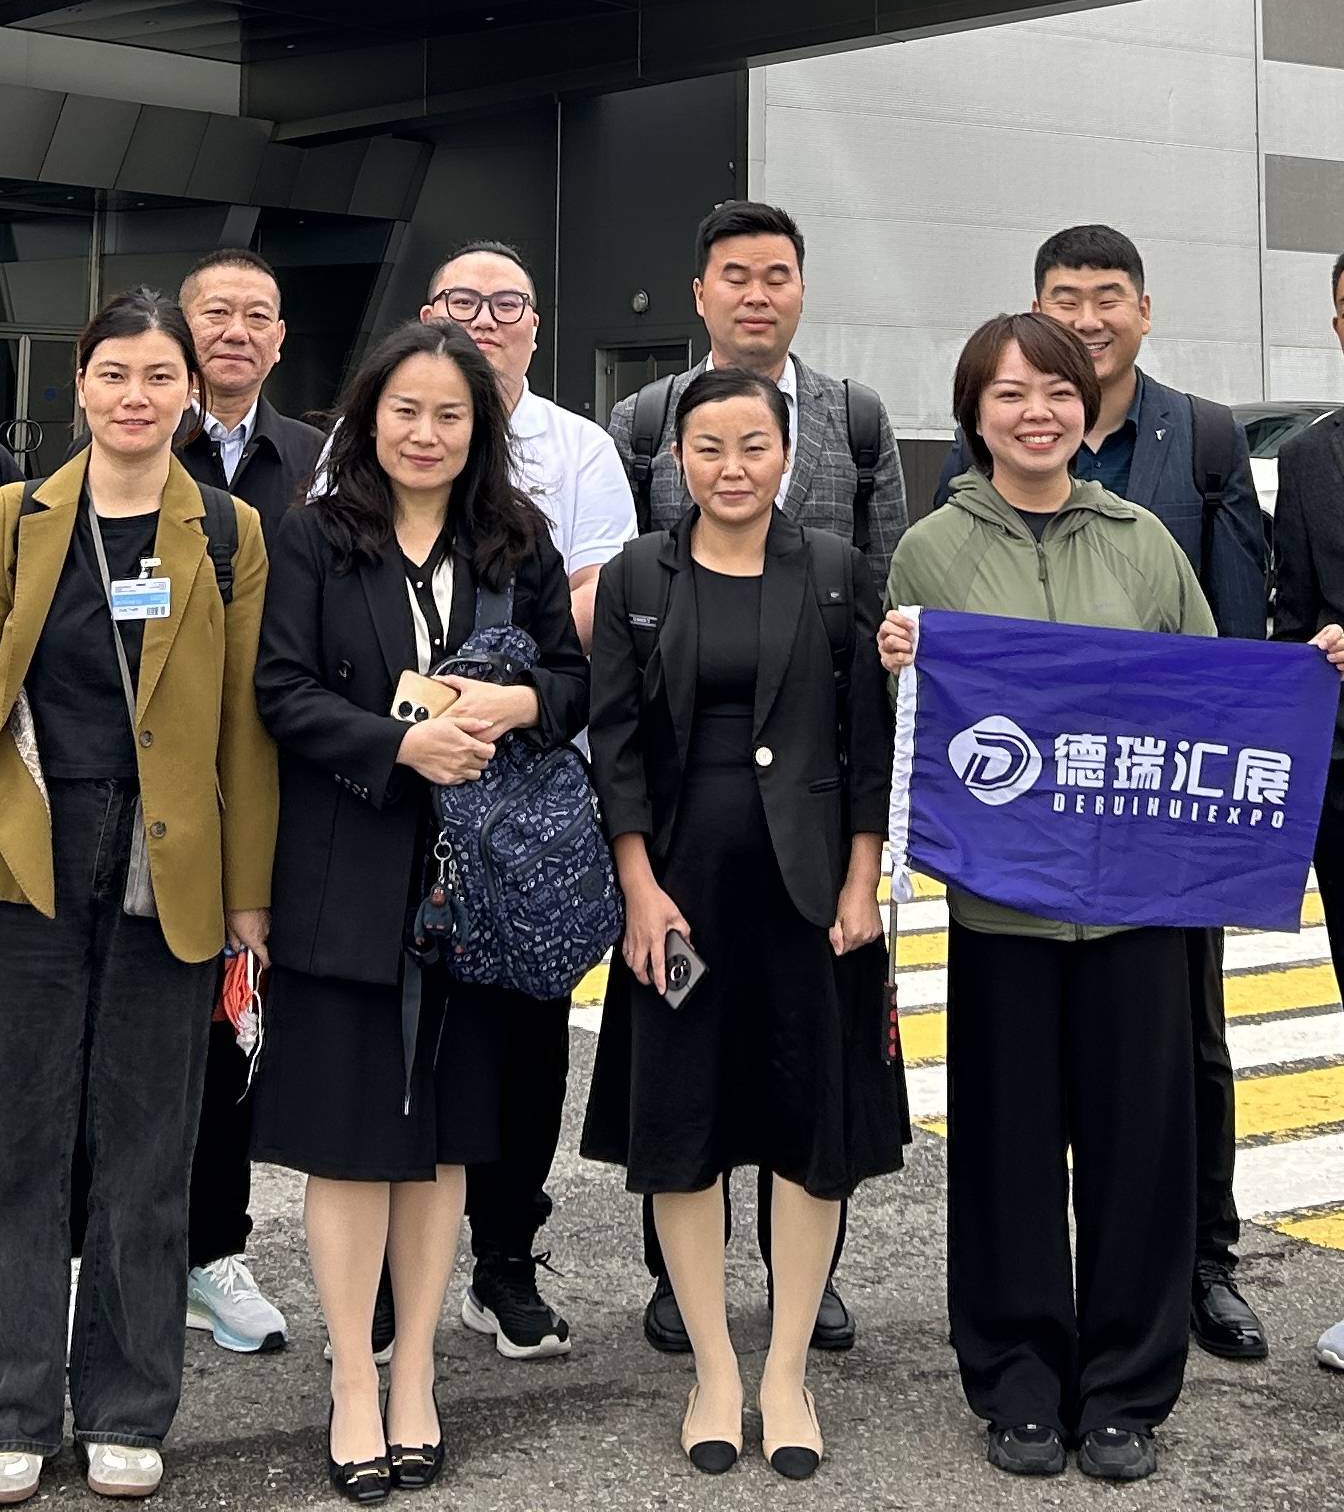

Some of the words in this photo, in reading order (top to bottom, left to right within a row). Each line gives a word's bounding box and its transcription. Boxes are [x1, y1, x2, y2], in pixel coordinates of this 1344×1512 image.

[1054, 732, 1293, 806] 德瑞汇展
[1052, 792, 1286, 830] DERUIHUIEXPO
